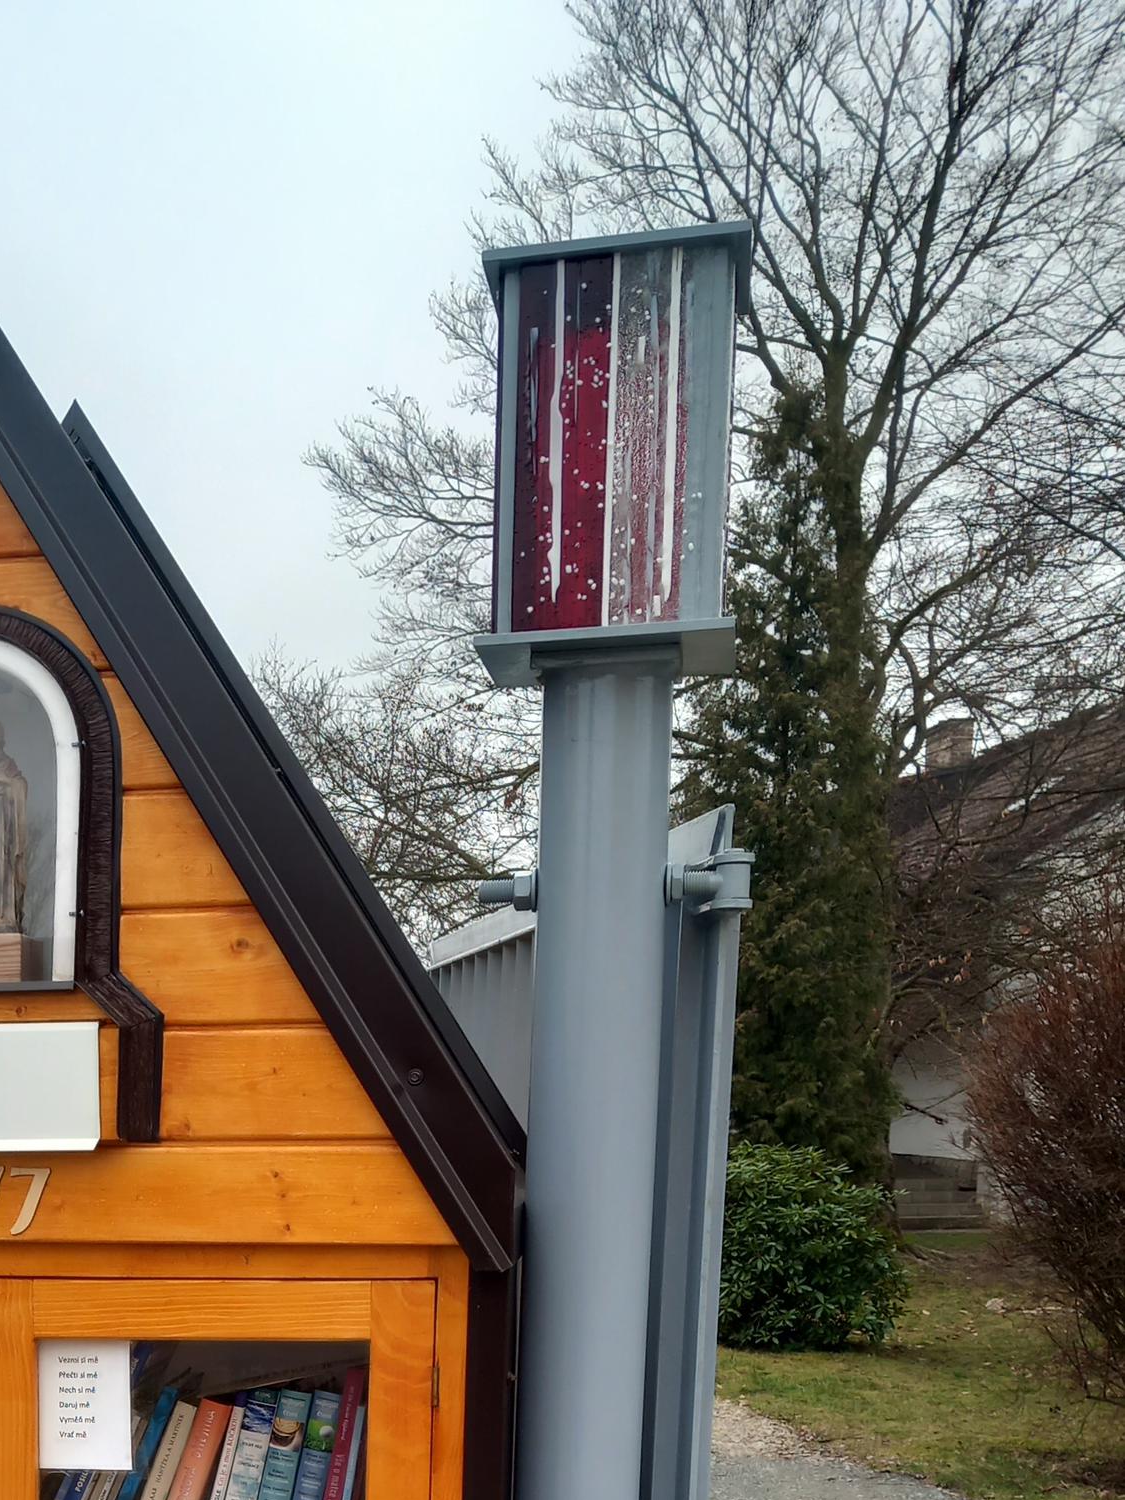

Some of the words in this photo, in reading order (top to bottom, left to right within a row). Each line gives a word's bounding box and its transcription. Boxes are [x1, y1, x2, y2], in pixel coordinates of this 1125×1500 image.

[58, 1356, 79, 1364] Vezmi
[80, 1356, 86, 1364] si
[87, 1356, 99, 1364] mě
[58, 1371, 78, 1379] Přečti
[80, 1371, 85, 1379] si
[86, 1371, 98, 1379] mě
[58, 1386, 76, 1394] Nech
[77, 1386, 83, 1394] si
[84, 1386, 96, 1394] mě
[59, 1401, 78, 1410] Daruj
[79, 1401, 90, 1409] mě
[59, 1416, 83, 1424] Vyměň
[84, 1416, 96, 1424] mě
[59, 1431, 74, 1439] Vrať
[75, 1431, 87, 1439] mě
